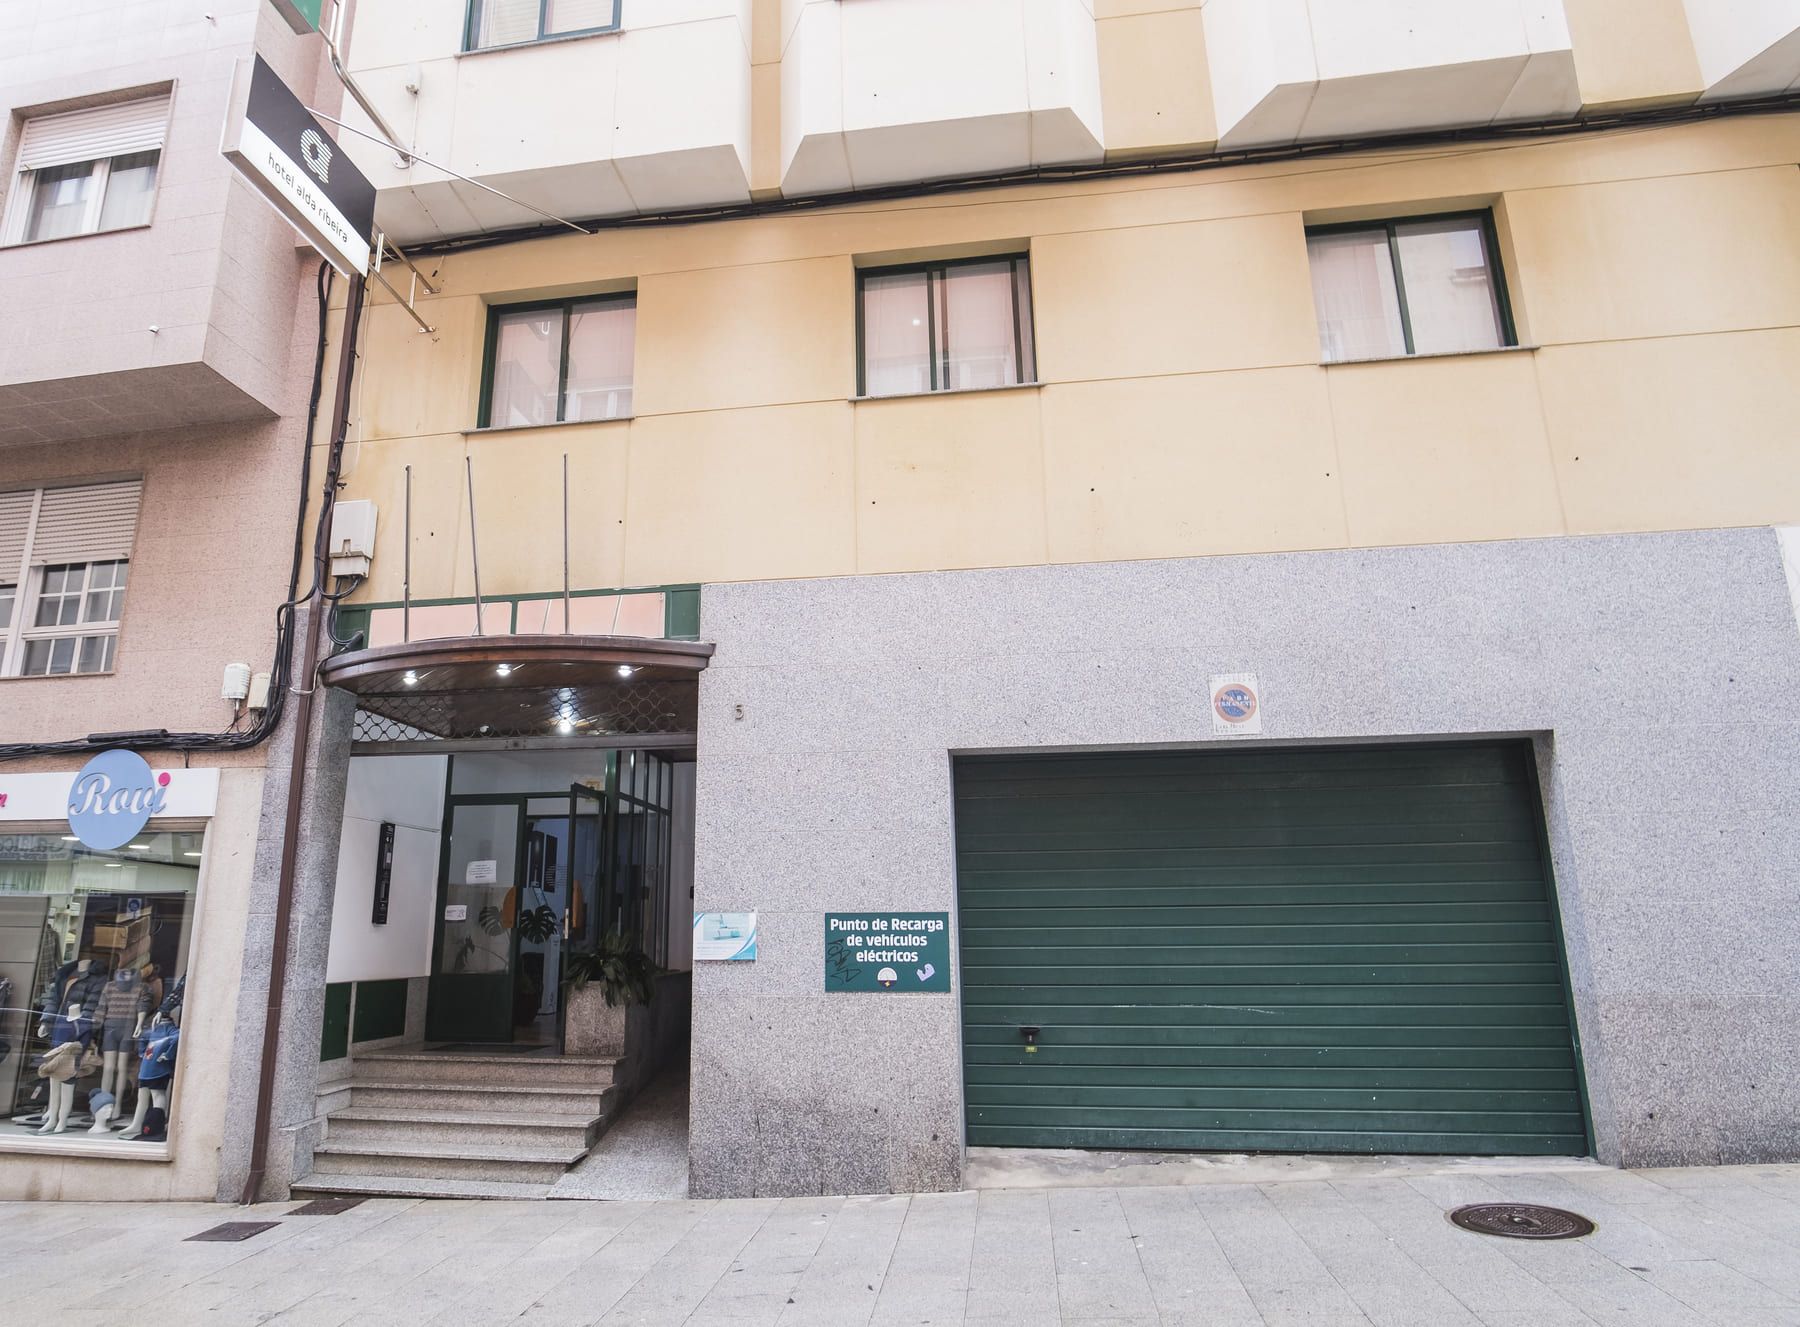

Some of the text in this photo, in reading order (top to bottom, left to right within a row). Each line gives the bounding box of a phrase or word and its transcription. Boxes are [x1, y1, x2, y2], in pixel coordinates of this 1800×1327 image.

[268, 152, 348, 243] hotel alda ribeira
[830, 918, 944, 932] Punto de Recarga
[846, 934, 928, 947] de vehículos
[856, 950, 919, 962] eléctricos
